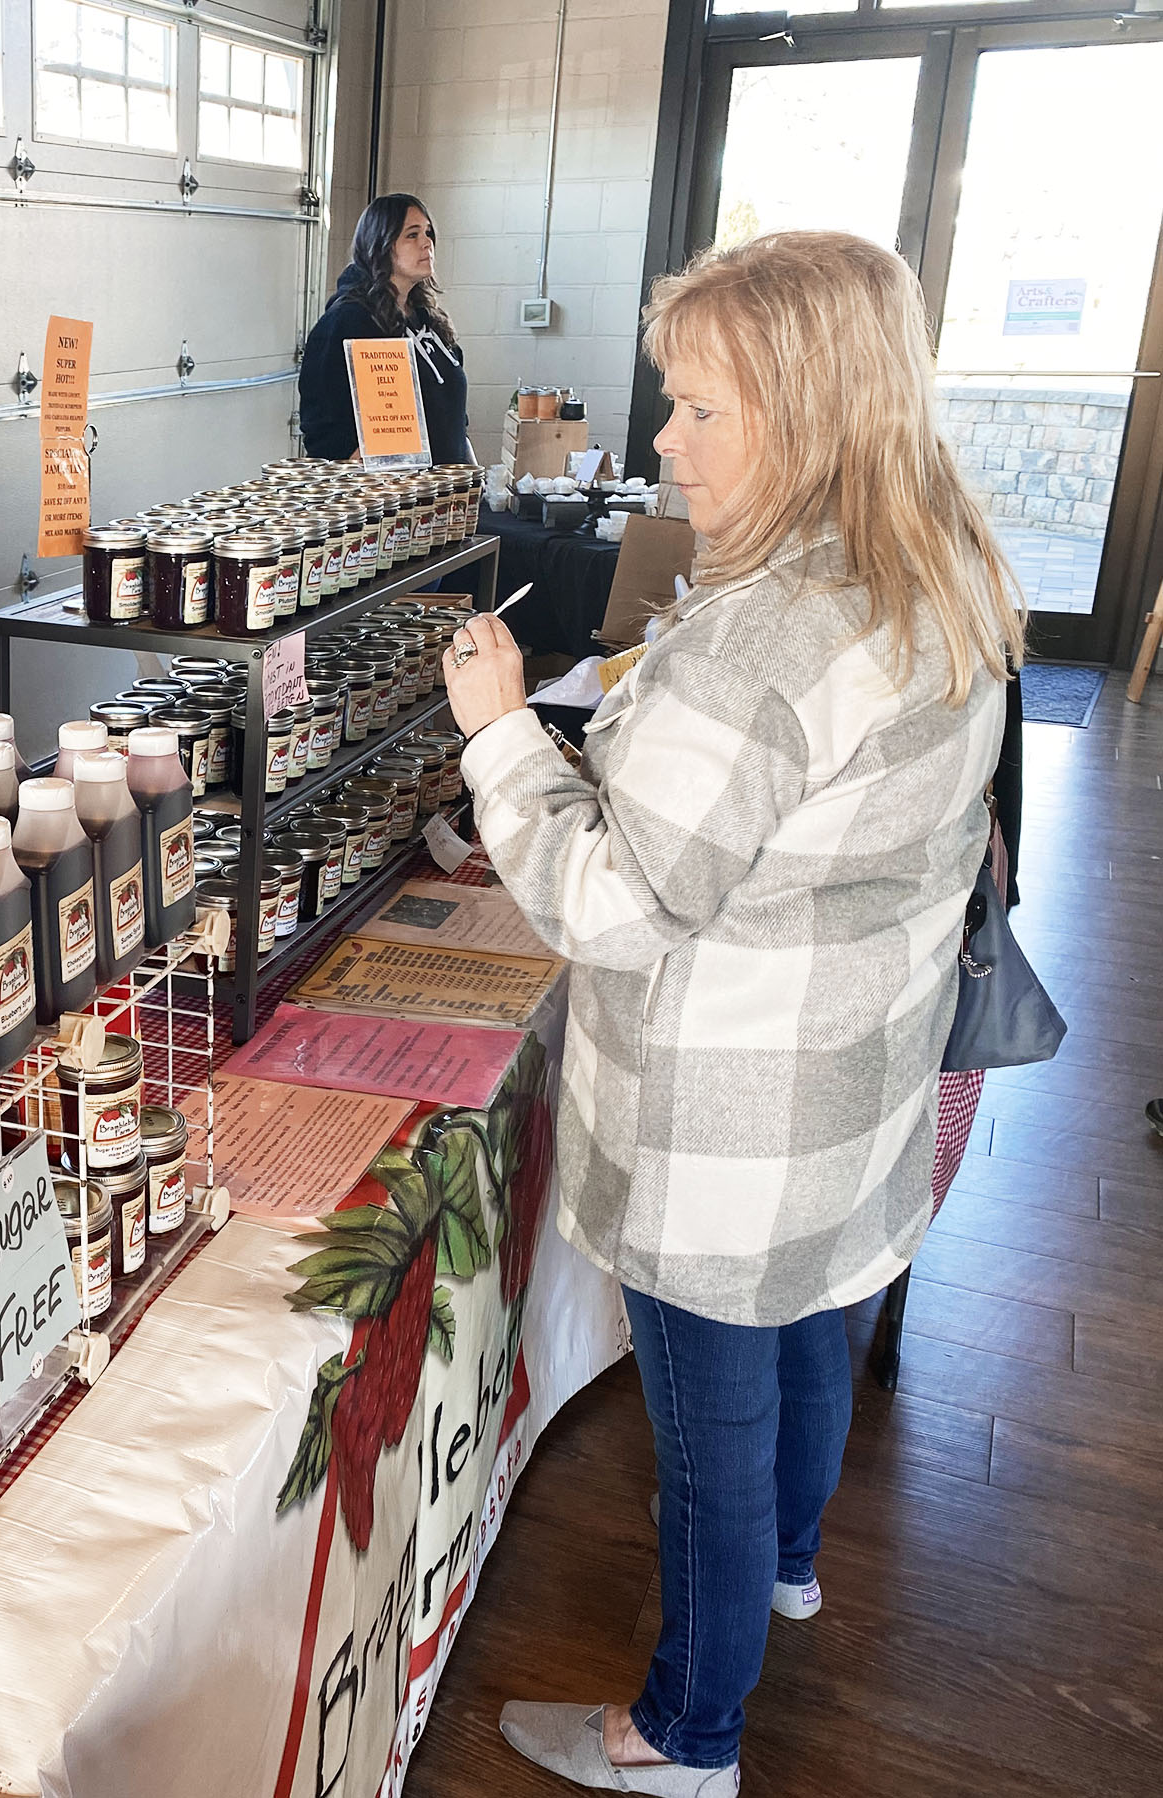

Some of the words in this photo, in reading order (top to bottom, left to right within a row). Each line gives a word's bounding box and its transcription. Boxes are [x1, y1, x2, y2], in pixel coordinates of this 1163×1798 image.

[1017, 287, 1043, 296] Arts
[1018, 296, 1078, 307] Crafters
[57, 359, 76, 370] SUPER
[371, 364, 383, 372] JAM
[377, 377, 395, 385] JELLY
[66, 513, 83, 521] ITEMS
